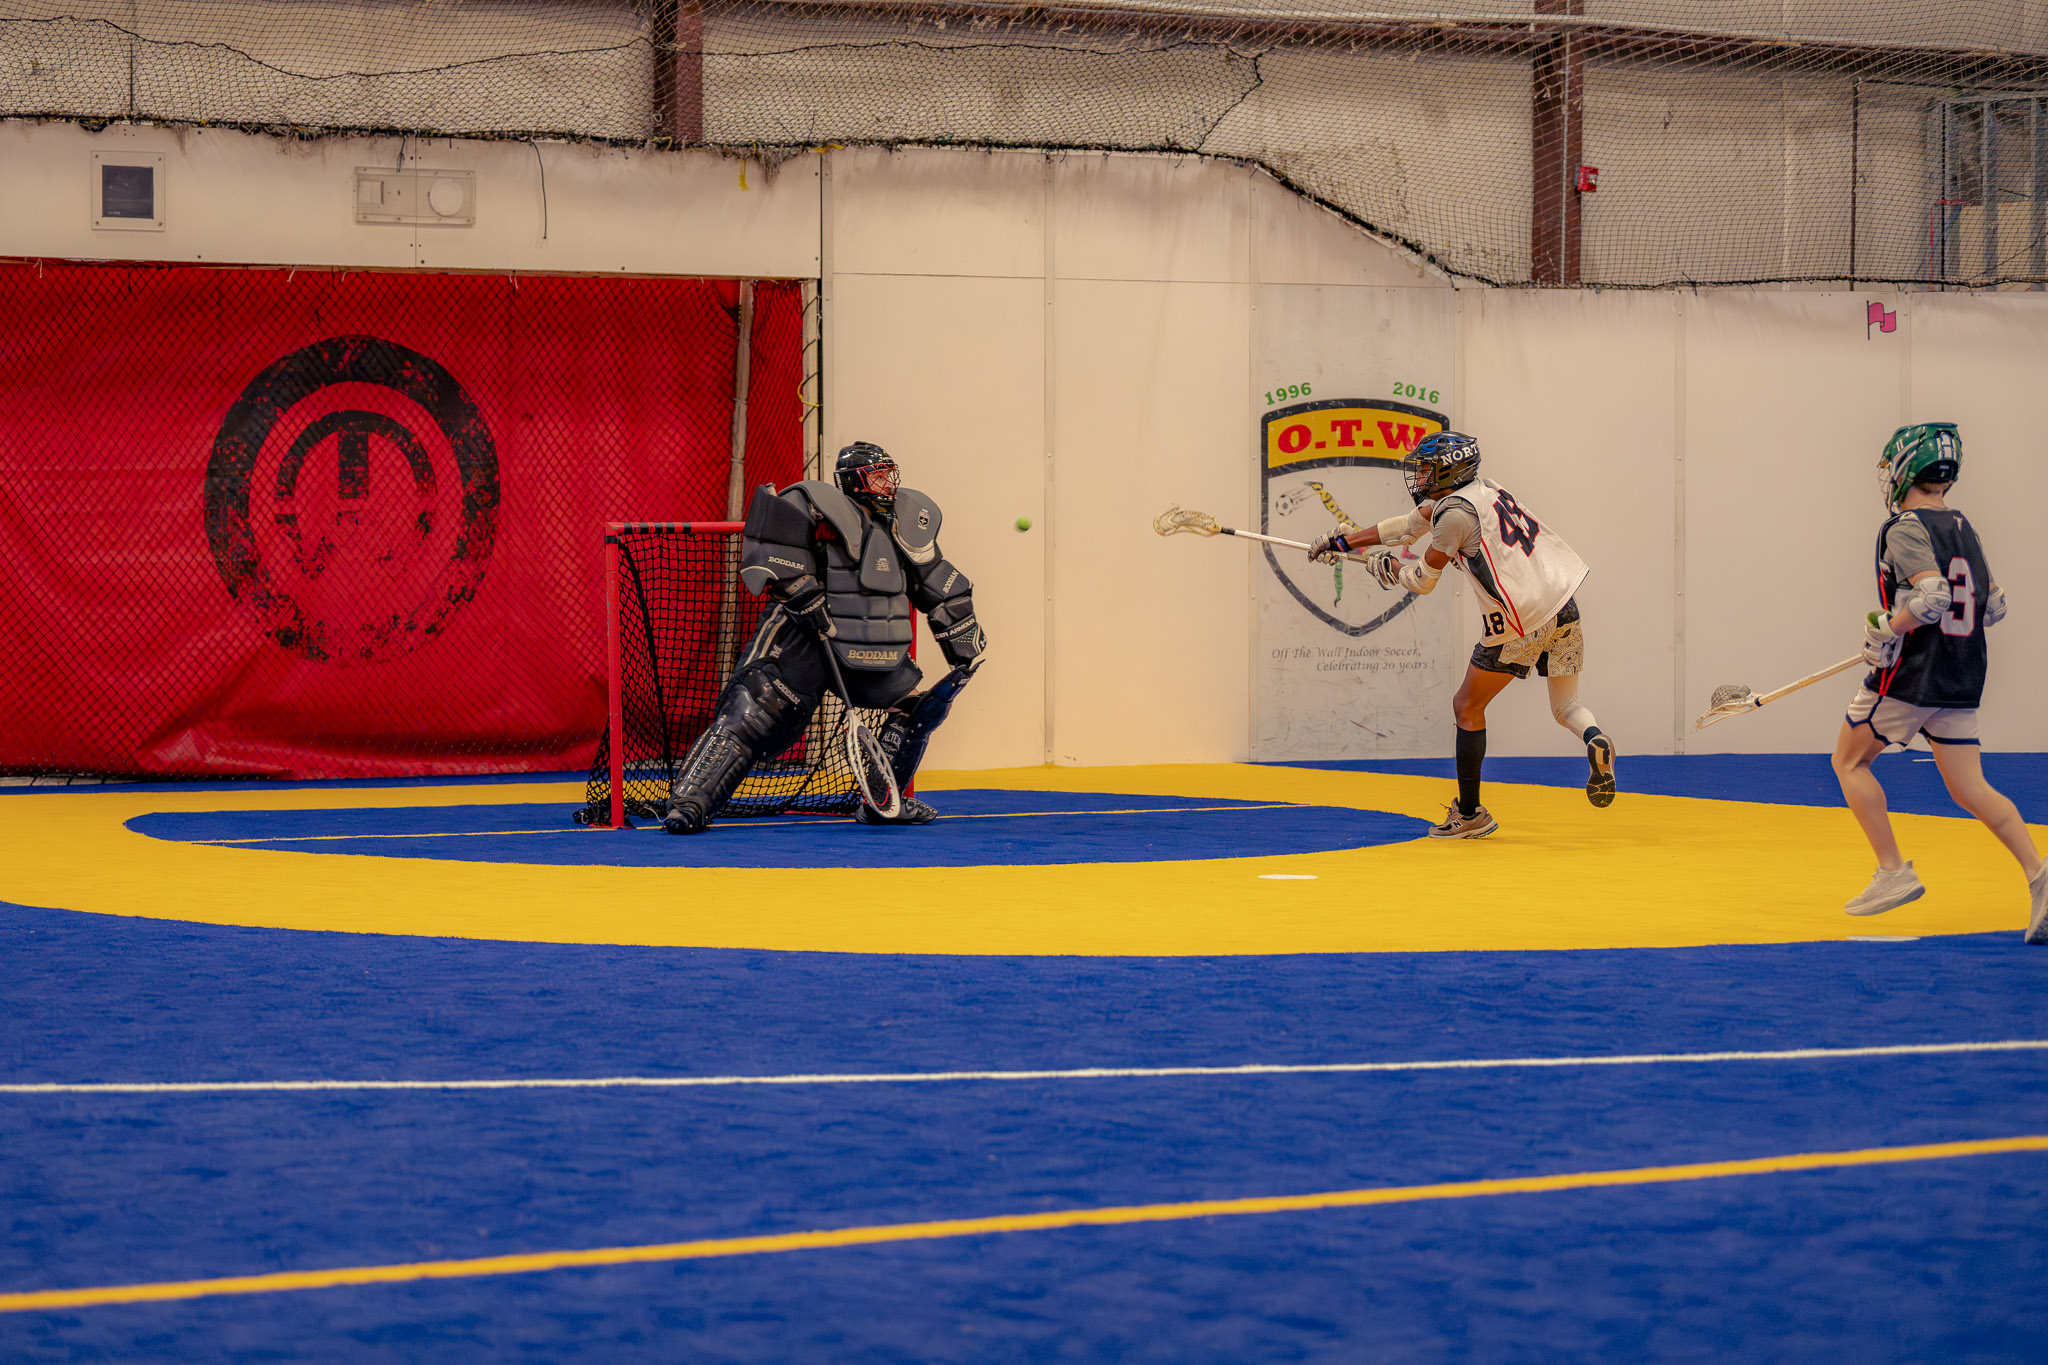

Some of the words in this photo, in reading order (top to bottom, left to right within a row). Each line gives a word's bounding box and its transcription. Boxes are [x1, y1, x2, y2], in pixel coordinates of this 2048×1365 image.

[1264, 382, 1312, 406] 1996
[1393, 381, 1441, 404] 2016
[768, 556, 805, 571] BODDAM
[942, 569, 960, 594] BODDAM
[1939, 556, 1975, 637] 3
[847, 648, 899, 660] BODDAM
[1271, 648, 1289, 662] Off
[1292, 646, 1311, 659] The
[1316, 646, 1343, 658] Wall
[1344, 646, 1380, 659] Indoor
[1316, 660, 1379, 673] Celebrating
[1382, 662, 1395, 670] 20
